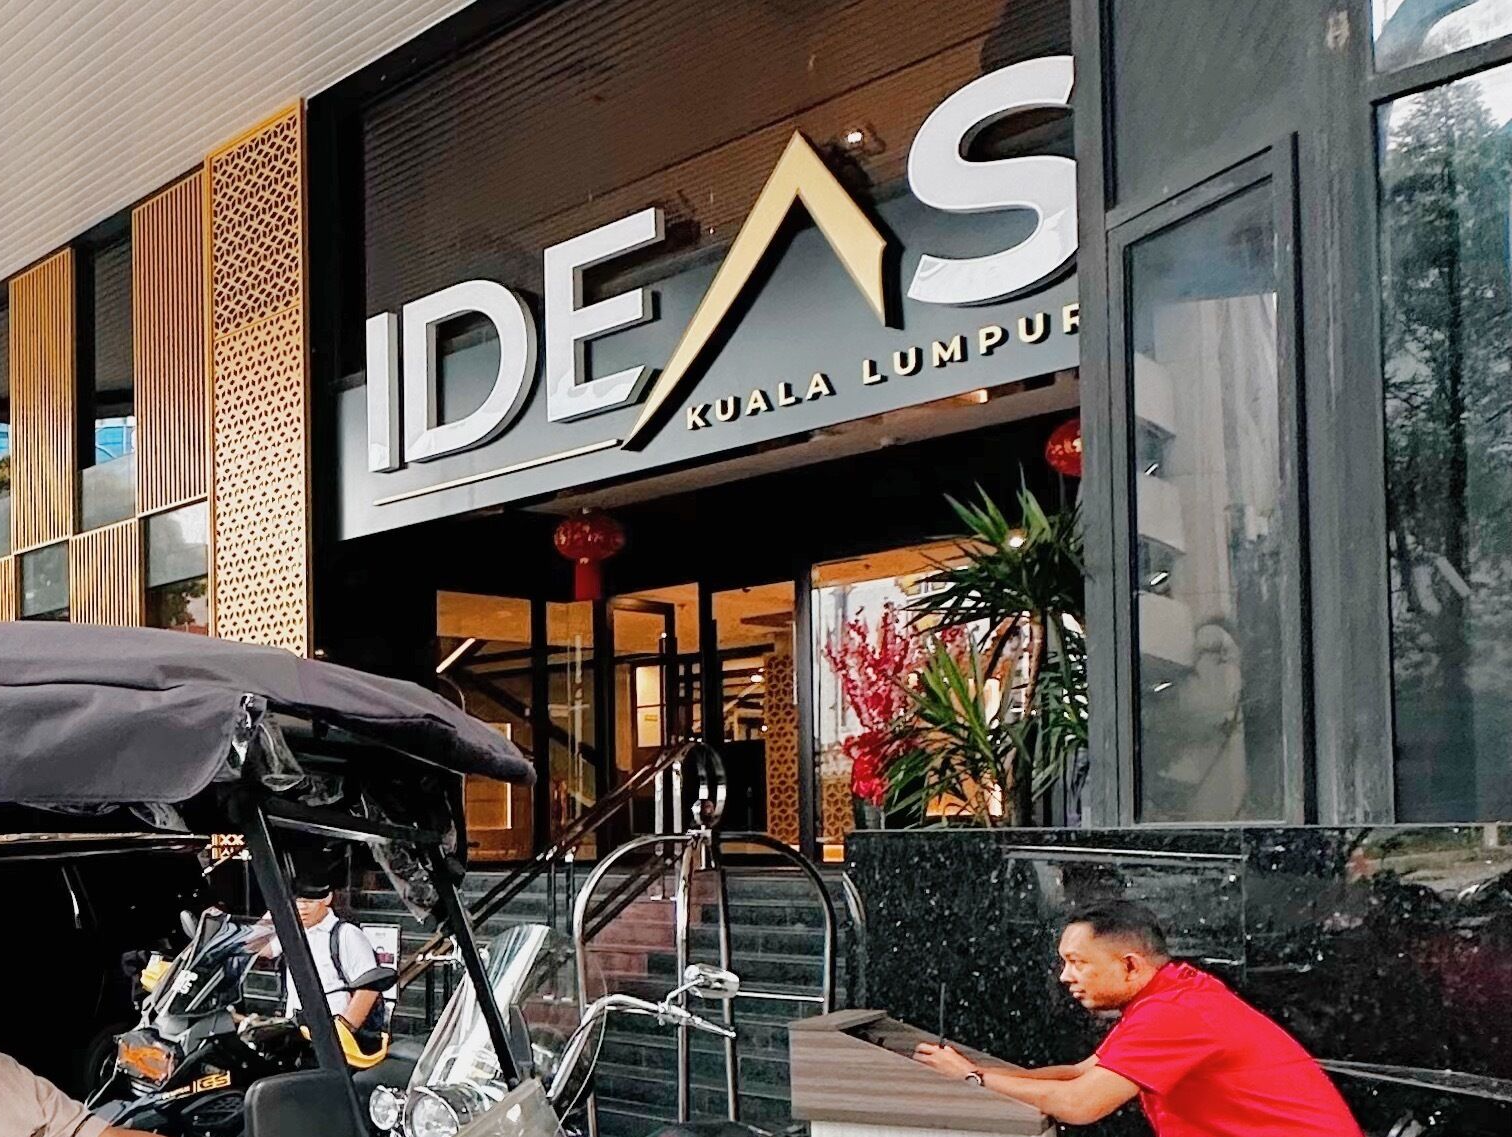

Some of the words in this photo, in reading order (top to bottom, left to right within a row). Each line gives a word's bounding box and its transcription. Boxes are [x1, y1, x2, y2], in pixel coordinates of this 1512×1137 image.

[366, 54, 1079, 473] IDEAS
[686, 371, 833, 431] KUALA
[862, 303, 1080, 387] LUMPUR
